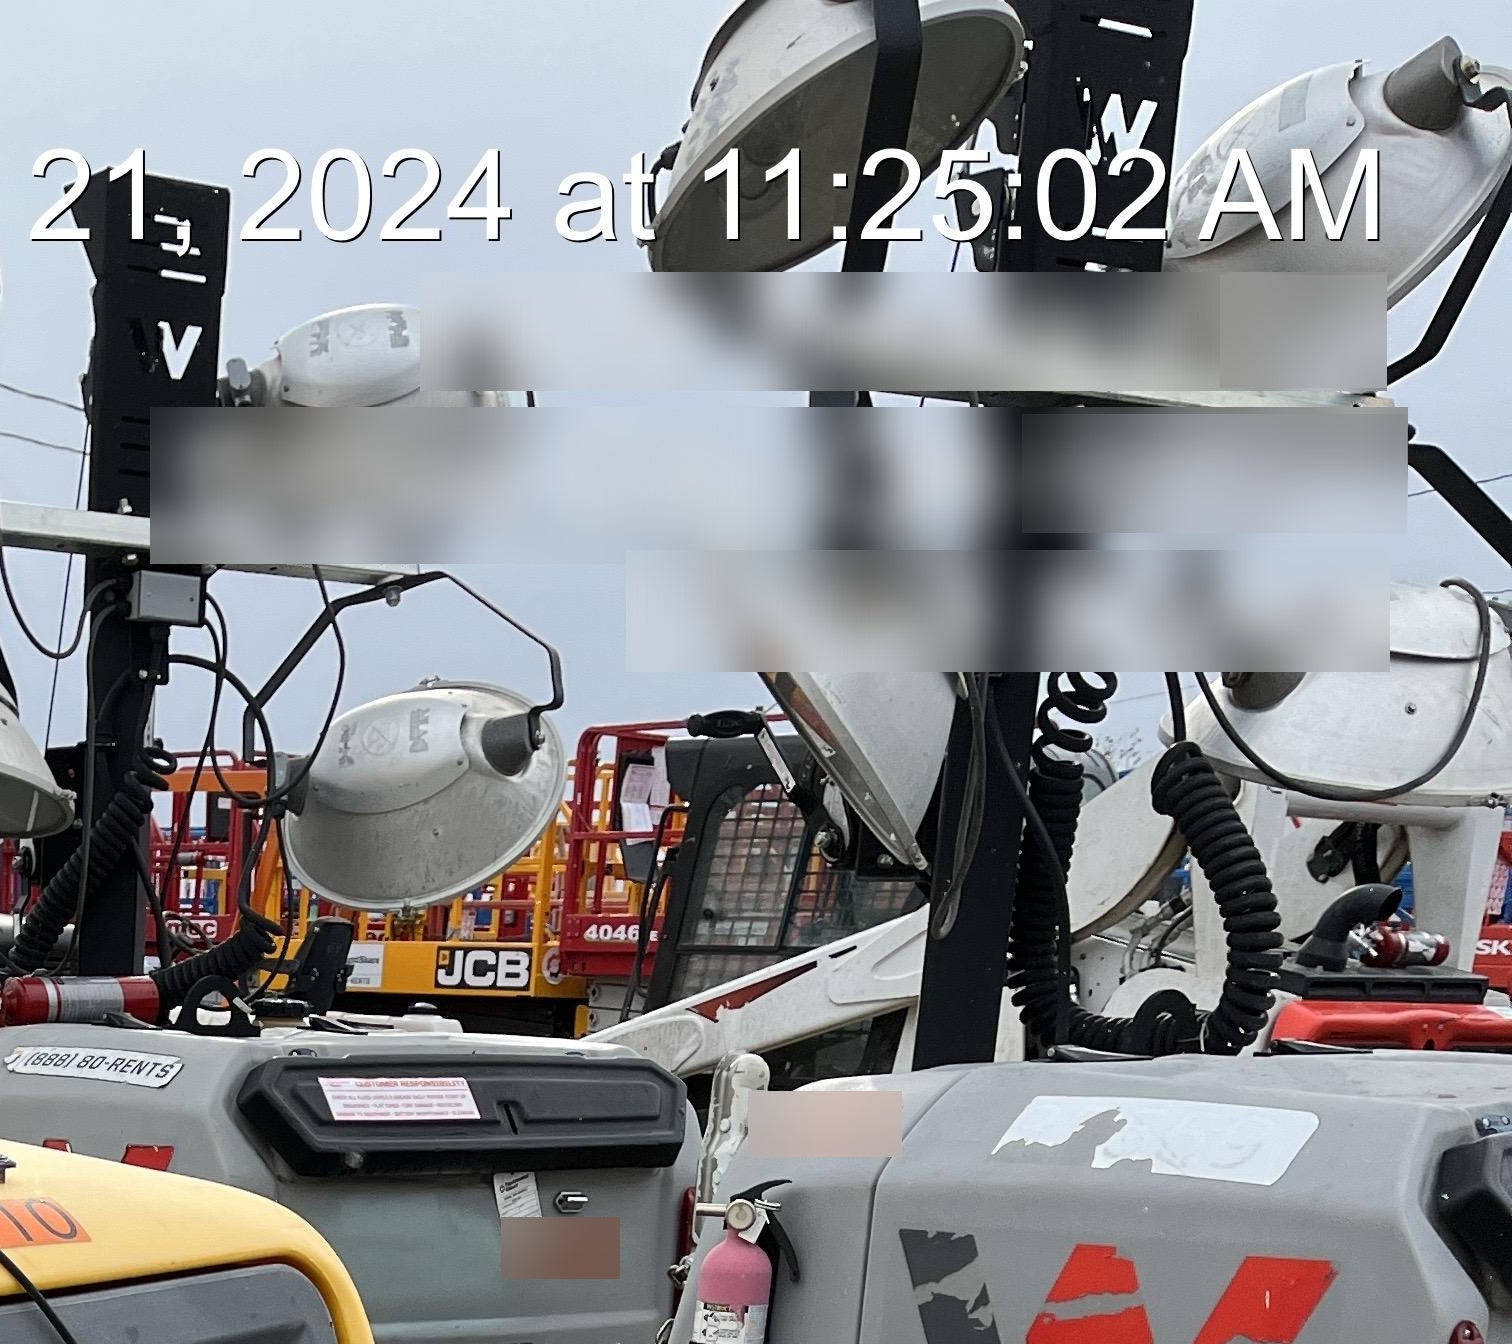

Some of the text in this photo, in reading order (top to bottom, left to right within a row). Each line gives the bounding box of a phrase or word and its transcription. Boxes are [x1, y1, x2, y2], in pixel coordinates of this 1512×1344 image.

[437, 949, 530, 988] JCB
[24, 1051, 175, 1079] (888) 80-RENTS
